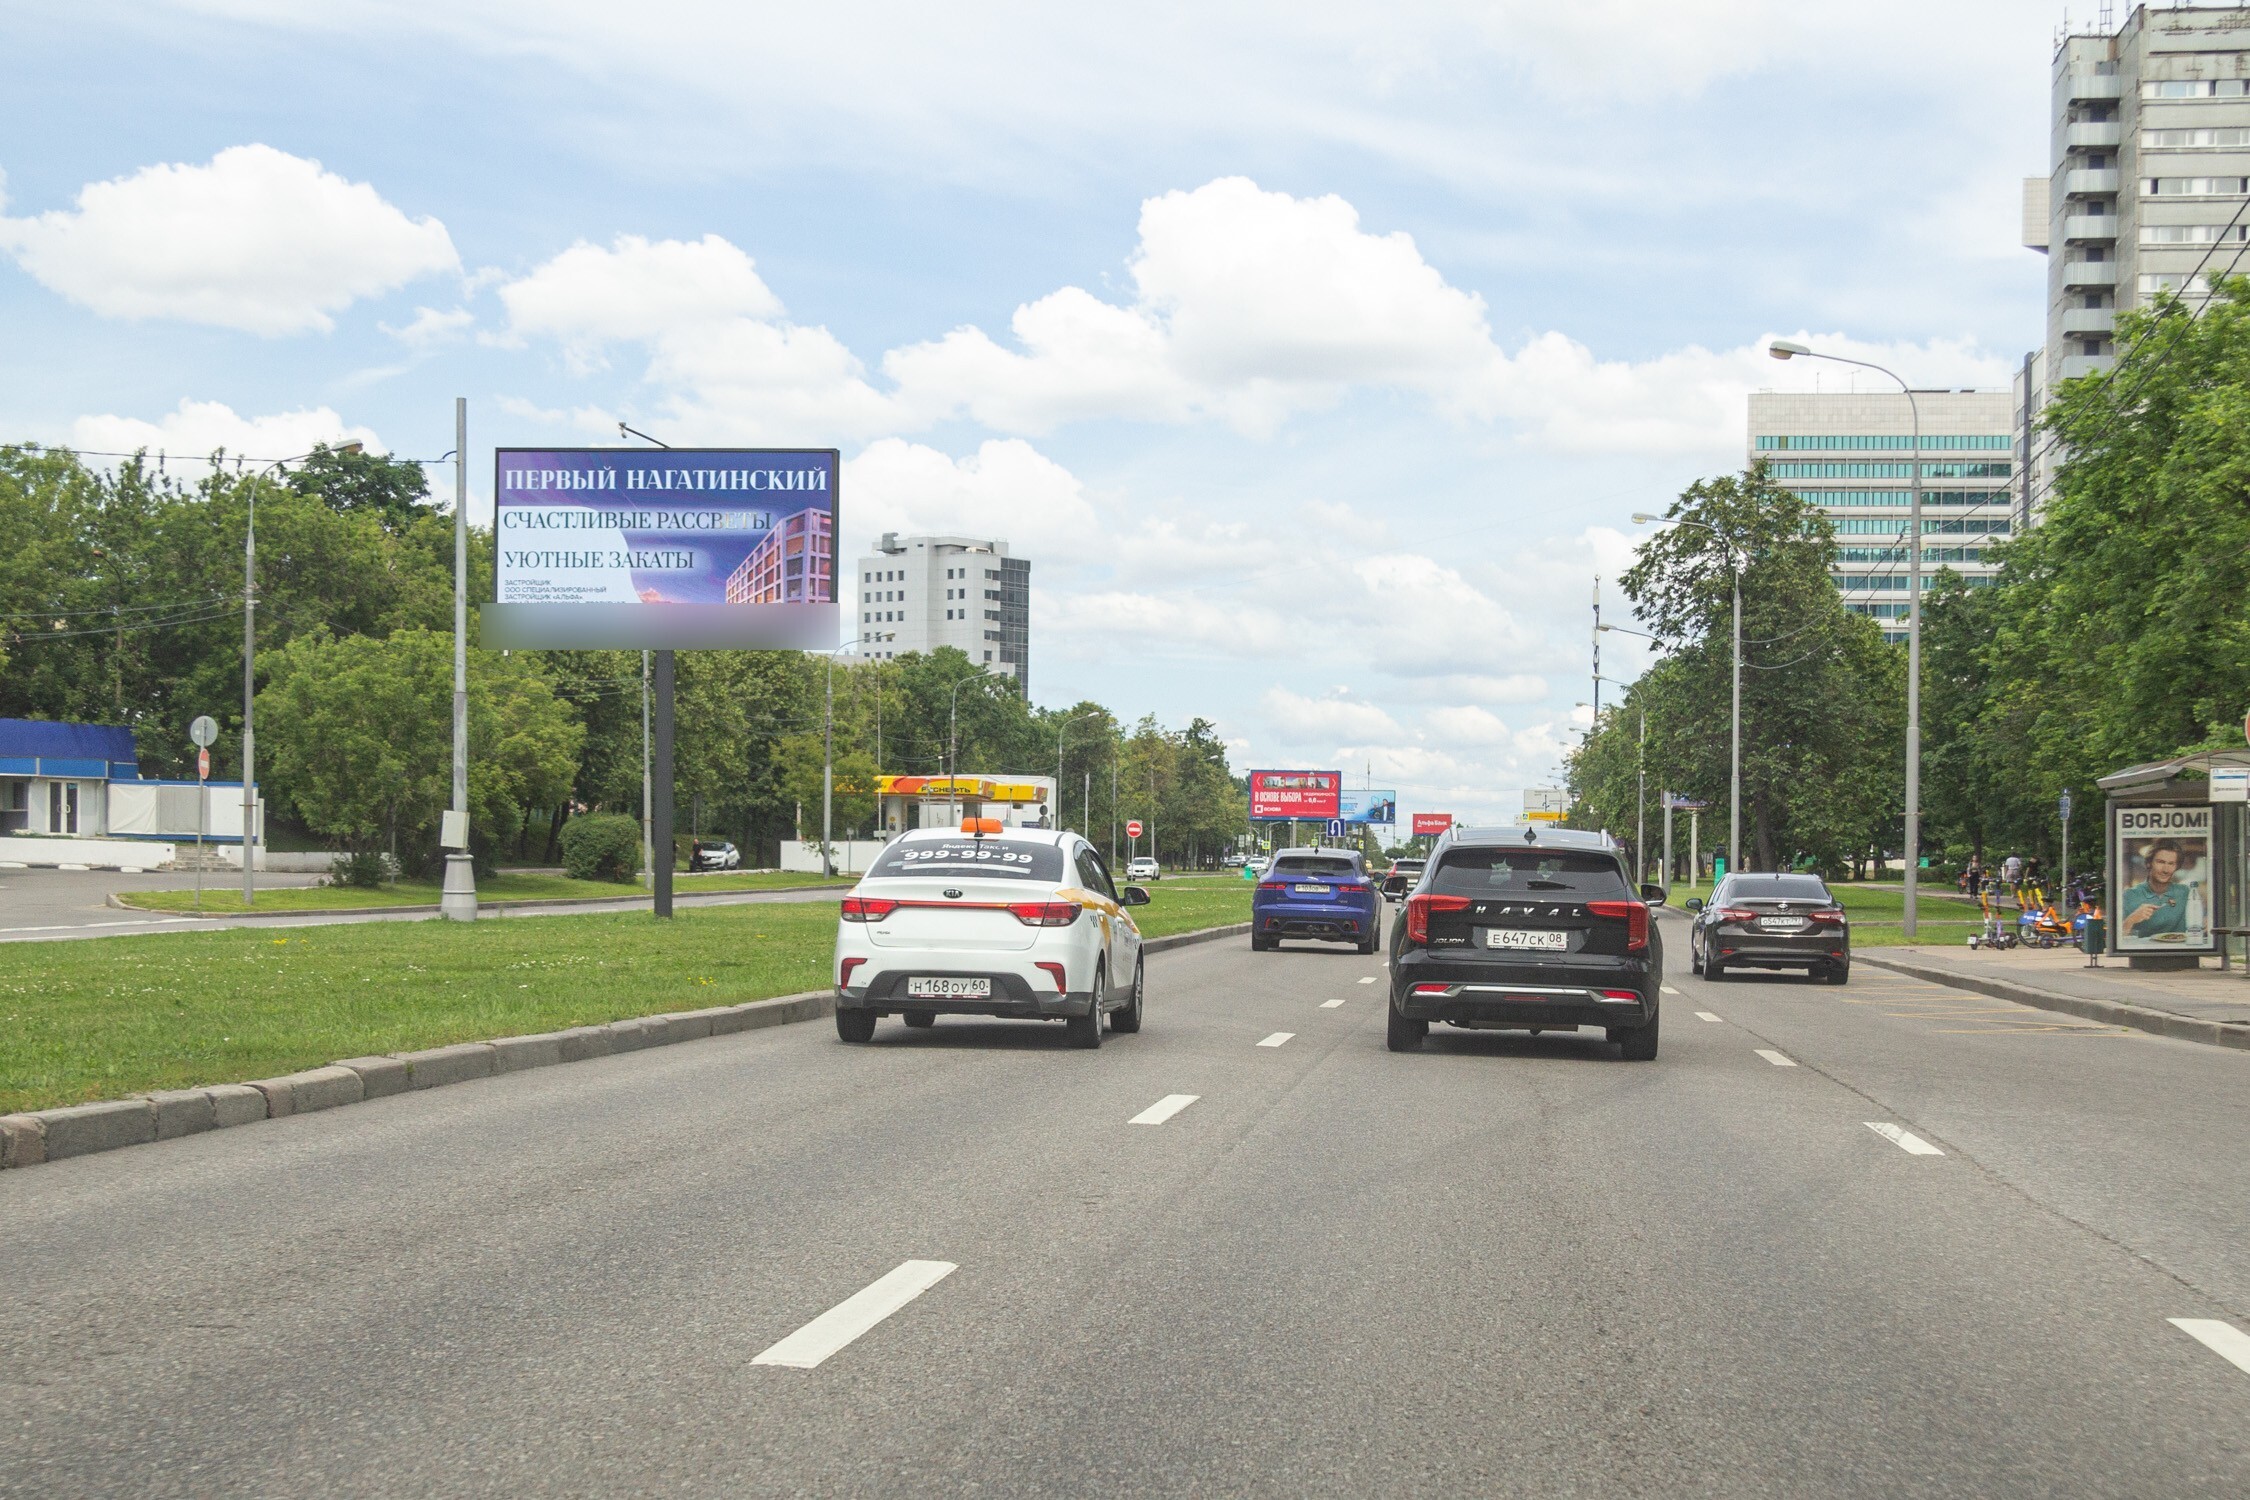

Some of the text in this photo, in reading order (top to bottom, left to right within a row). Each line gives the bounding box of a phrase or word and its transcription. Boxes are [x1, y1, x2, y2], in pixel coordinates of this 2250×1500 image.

[505, 465, 827, 491] ПЕРВЫЙ НАГАТИНСКИЙ
[503, 511, 771, 530] СЧАСТЛИВЫЕ РАССВЕТЫ
[504, 550, 694, 569] УЮТНЫЕ ЗАКАТЫ
[2121, 812, 2208, 829] BORJOMI
[903, 850, 1033, 863] 999-99-99
[1475, 906, 1581, 917] HAVAL
[1548, 933, 1562, 943] 08
[971, 980, 986, 990] 60
